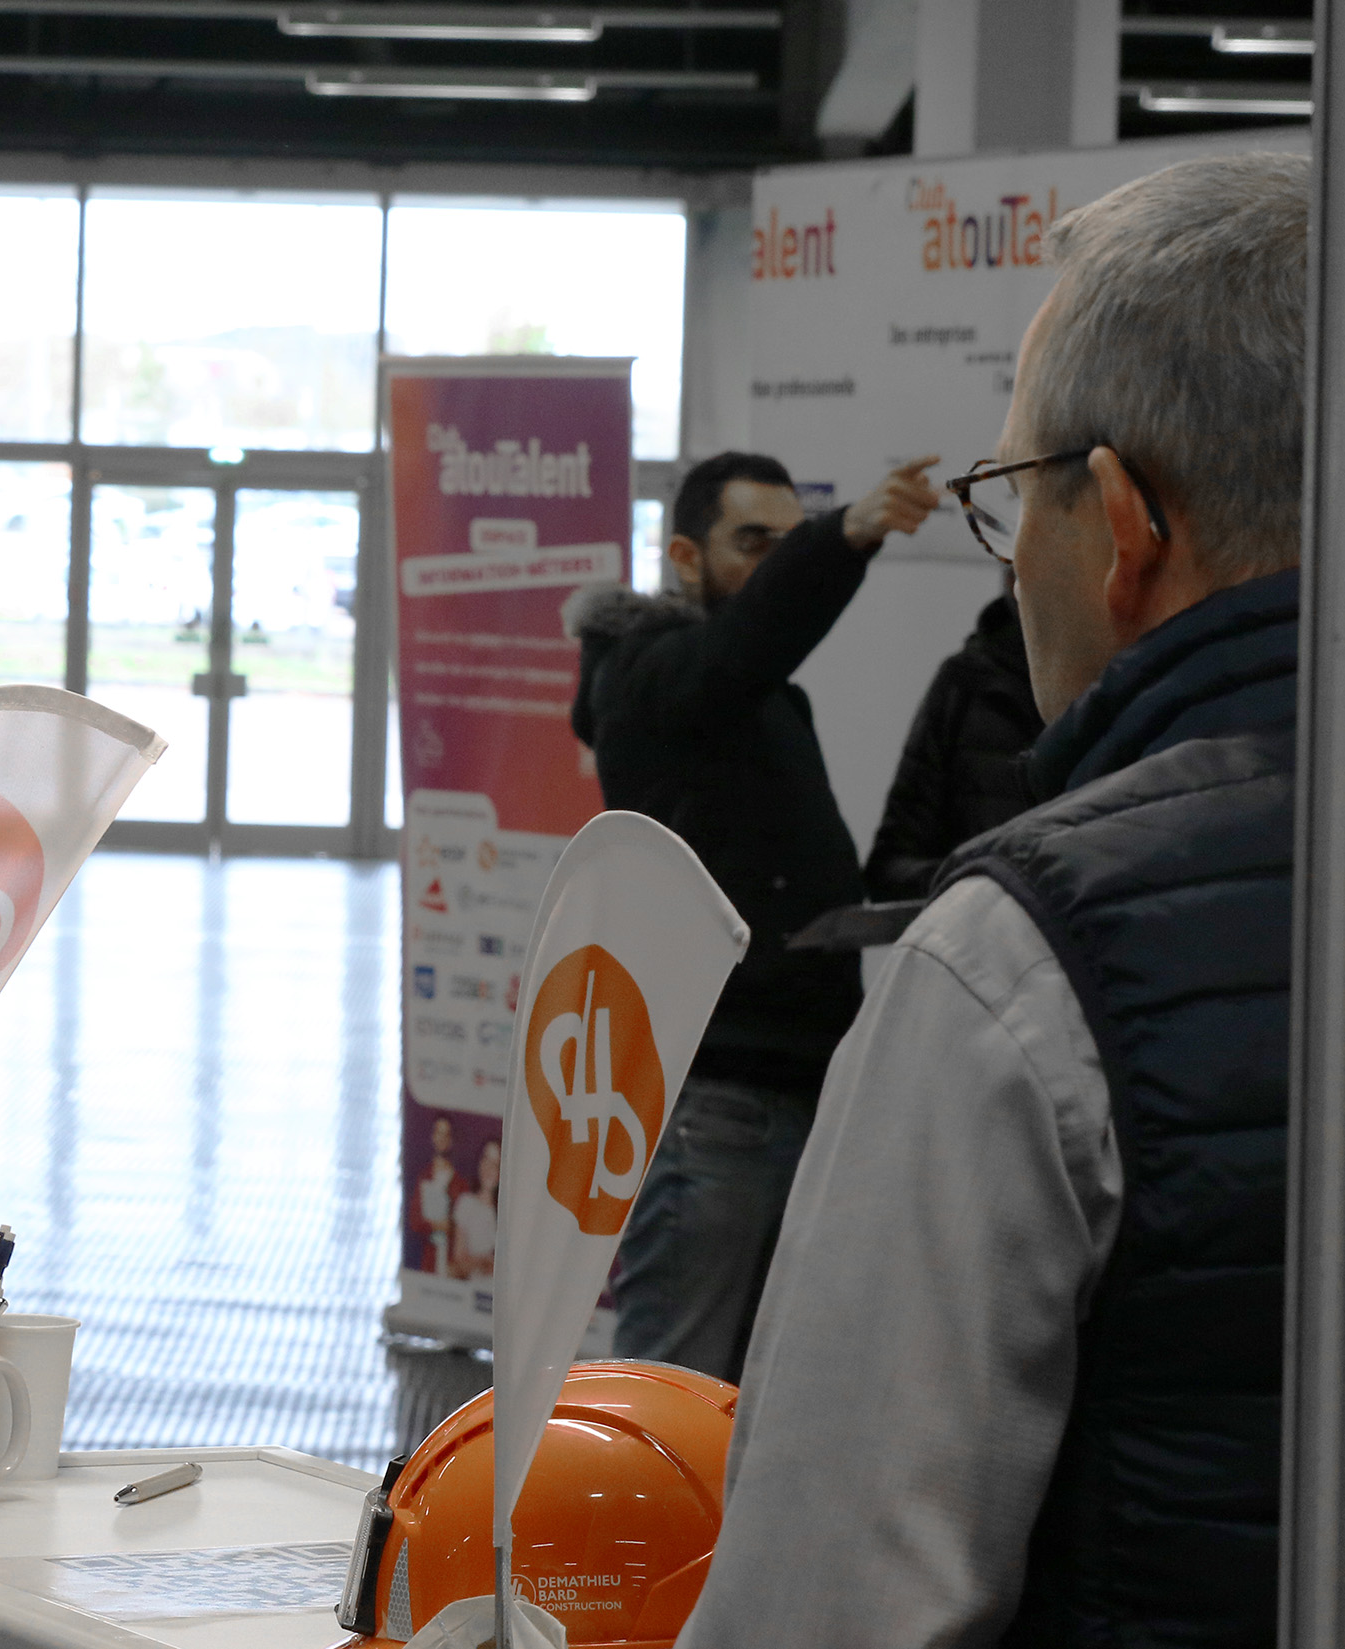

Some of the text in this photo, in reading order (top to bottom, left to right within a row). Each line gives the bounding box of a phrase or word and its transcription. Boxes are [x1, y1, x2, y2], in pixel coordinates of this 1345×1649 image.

[537, 1574, 622, 1589] DEMATHIEU
[538, 1588, 578, 1602] BARD
[539, 1600, 623, 1612] CONSTRUCTION
